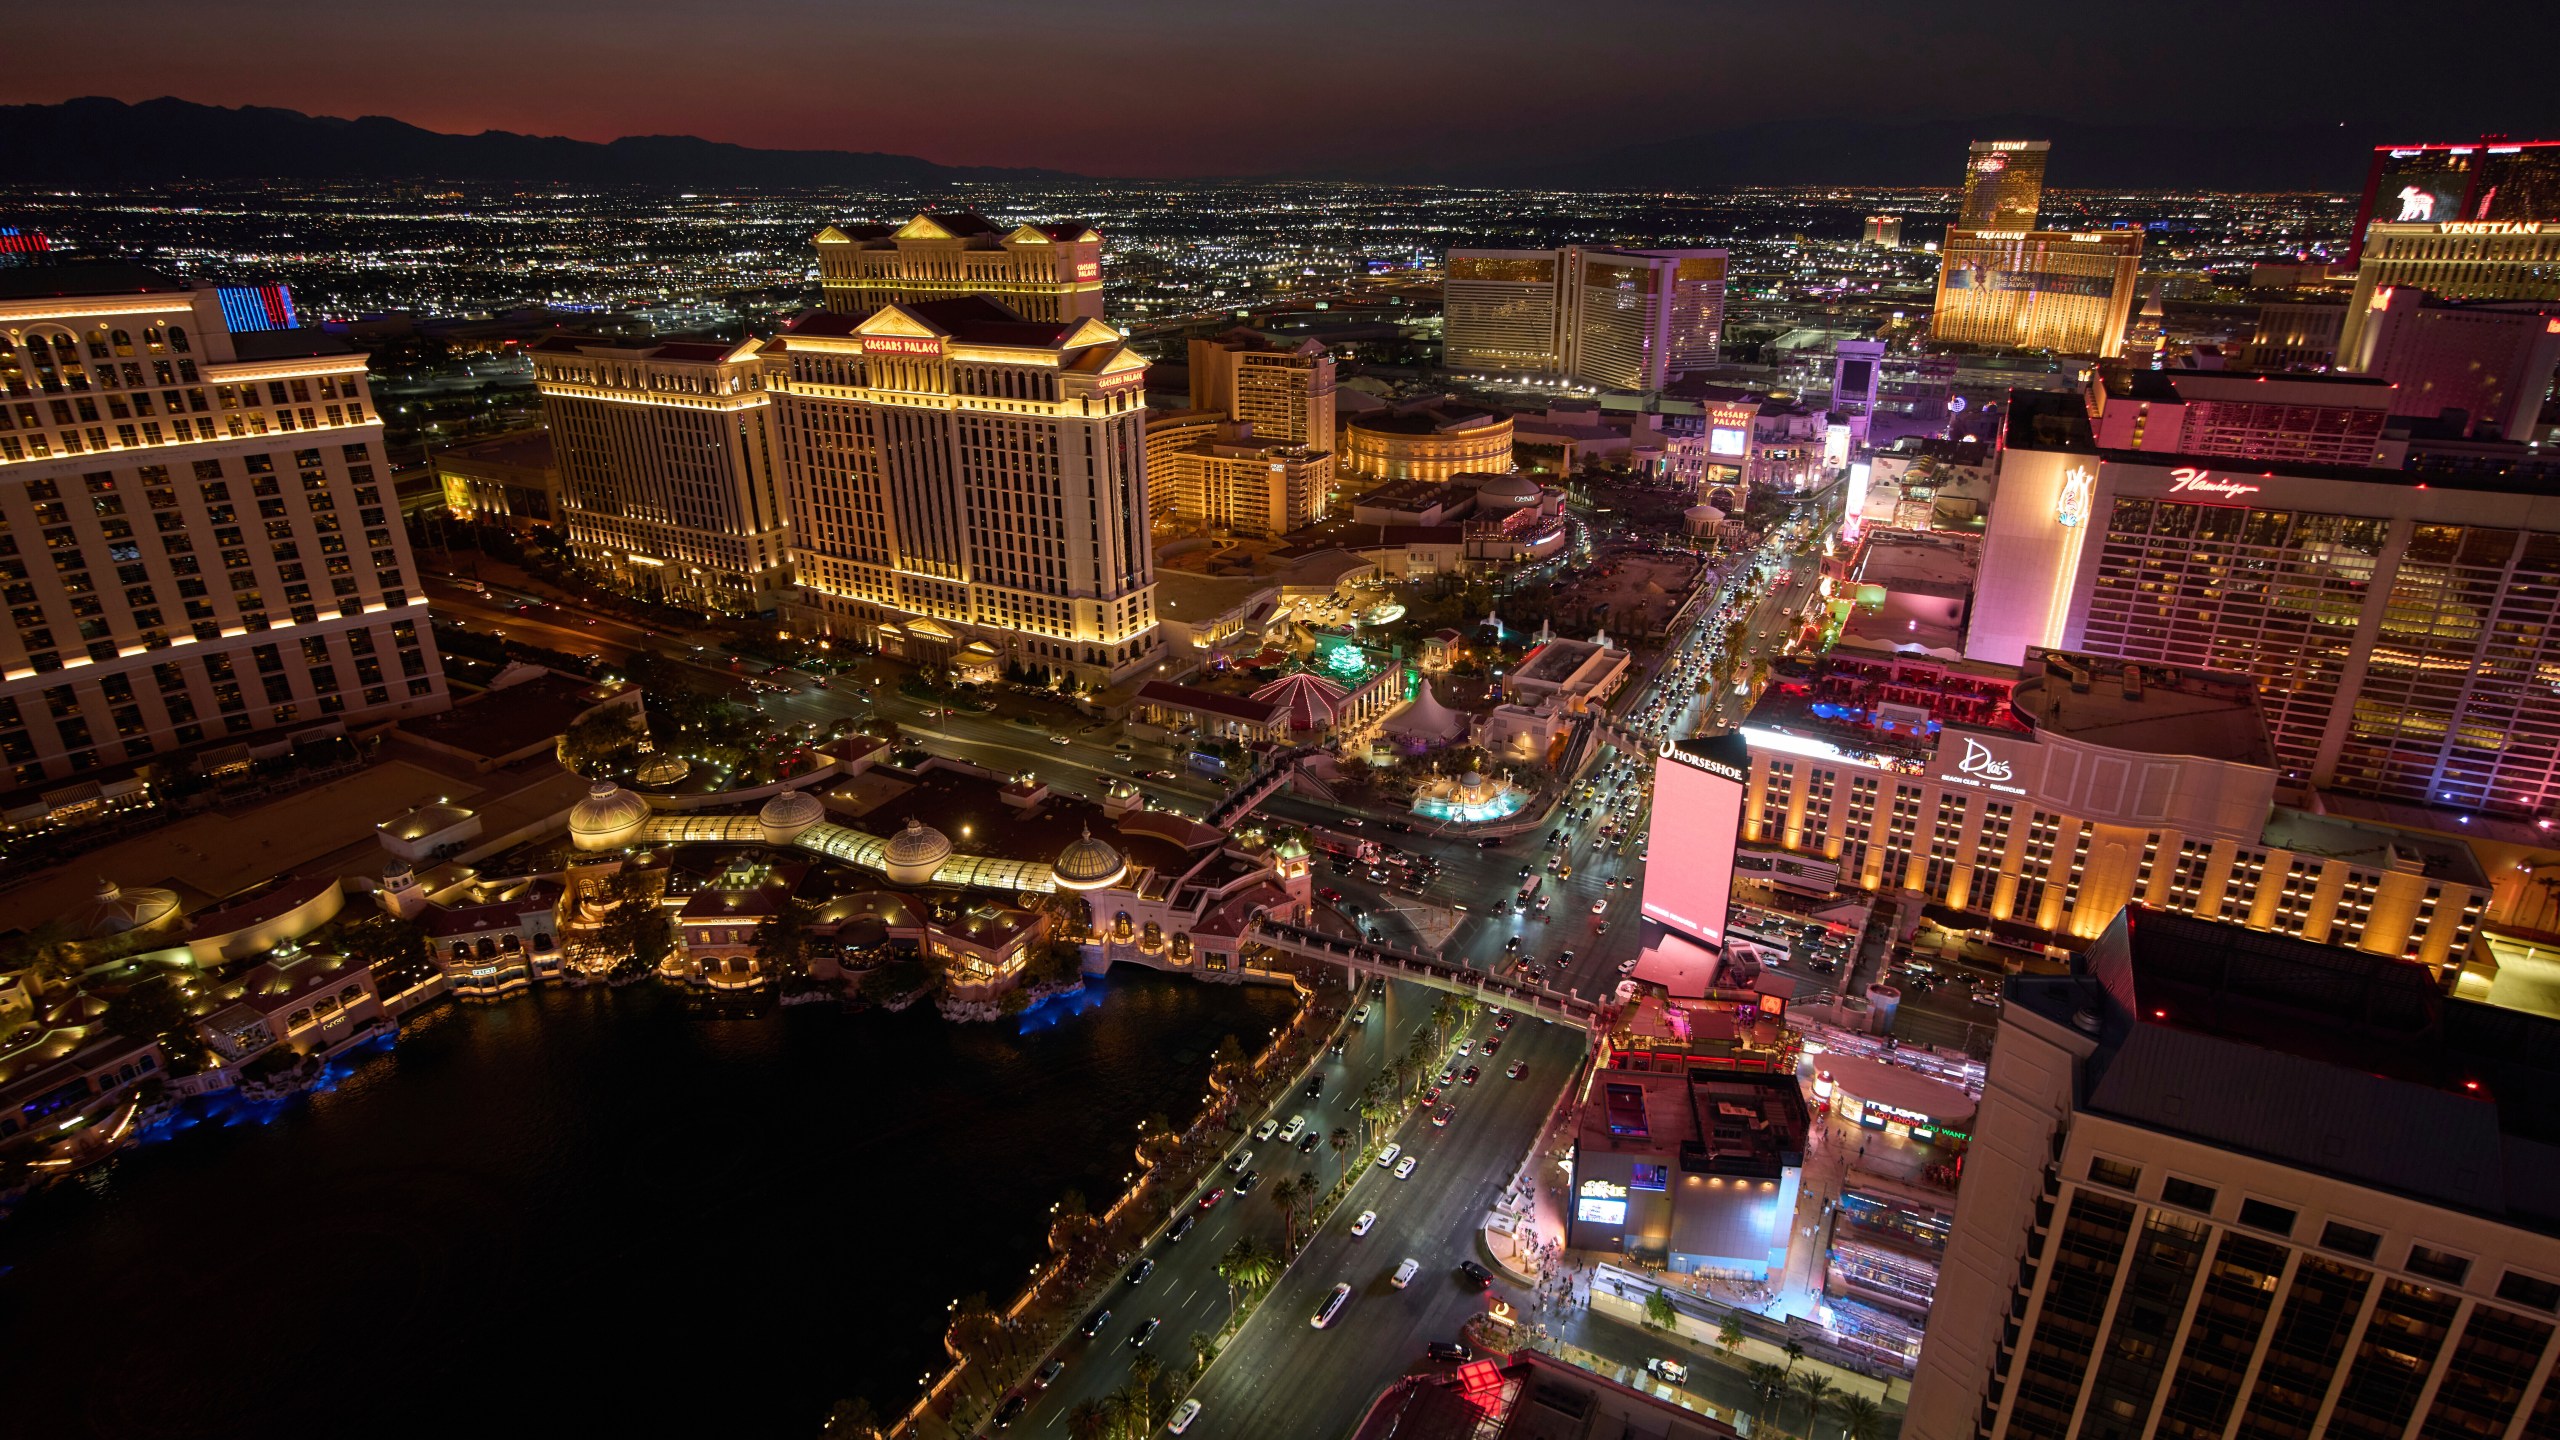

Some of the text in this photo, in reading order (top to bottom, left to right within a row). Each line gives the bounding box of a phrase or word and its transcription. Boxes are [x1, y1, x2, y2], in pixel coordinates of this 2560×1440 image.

[1992, 141, 2028, 150] TRUMP
[2440, 222, 2541, 234] VENETIAN
[1976, 231, 2102, 242] TREASURE ISLAND
[865, 340, 939, 354] CAESARS PALACE
[1099, 372, 1143, 388] CAESARS PALACE
[1713, 410, 1749, 419] CAESARS
[1714, 418, 1746, 427] PALACE
[2169, 468, 2259, 499] Flamingo
[1674, 749, 1743, 781] HORSESHOE
[1959, 737, 2012, 781] Drai's
[1941, 774, 2026, 795] BEACH CLUB NIGHTCLUB
[1873, 1110, 1891, 1120] YOU
[1893, 1115, 1920, 1127] KNOW
[1941, 1127, 1967, 1140] WANT
